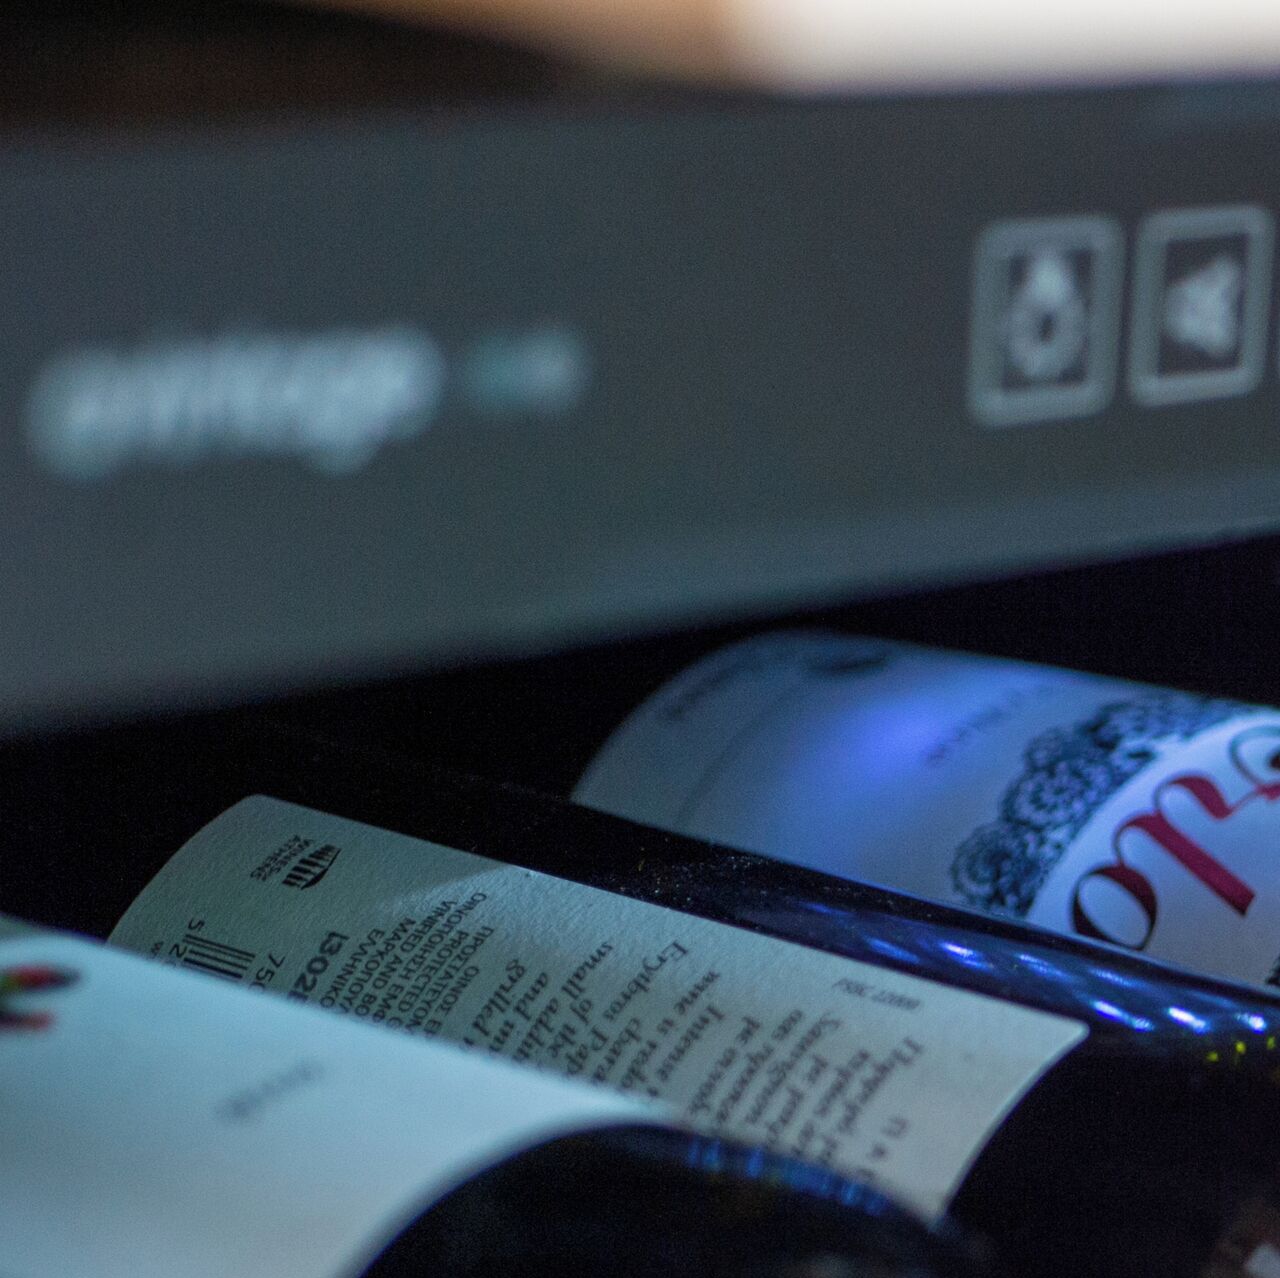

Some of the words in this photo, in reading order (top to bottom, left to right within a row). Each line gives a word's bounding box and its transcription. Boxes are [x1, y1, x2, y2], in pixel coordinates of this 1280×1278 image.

[399, 899, 457, 953] VINIFIED
[399, 891, 488, 980] ΟΙΝΟΠΟΙΗΣΗ
[371, 953, 403, 990] AND
[390, 929, 469, 1013] PROTECTED
[434, 964, 480, 1016] ΟΙΝΟΣ
[512, 970, 549, 1021] and
[560, 941, 614, 1000] small
[602, 941, 688, 1021] Erythros
[673, 971, 719, 1015] wine
[470, 957, 527, 1038] grilled
[568, 992, 594, 1026] of
[546, 1022, 577, 1060] the
[655, 1003, 725, 1082] Intense
[656, 1016, 676, 1036] is
